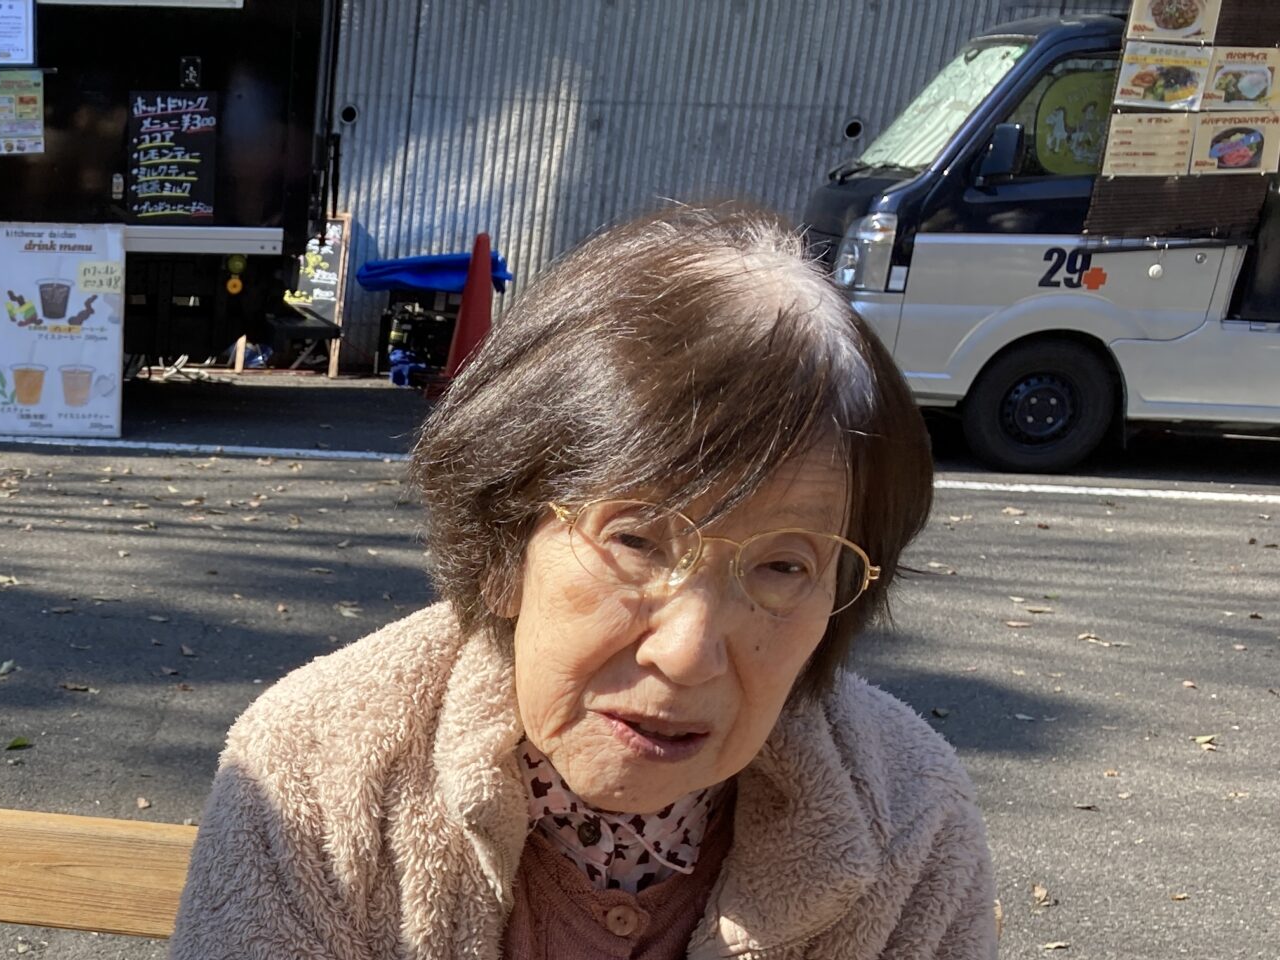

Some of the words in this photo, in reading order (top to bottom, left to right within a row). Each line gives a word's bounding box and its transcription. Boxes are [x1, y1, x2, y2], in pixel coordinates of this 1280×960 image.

[132, 96, 208, 115] ホットドリンク
[140, 131, 174, 144] ココア
[140, 147, 200, 160] レモンティー
[139, 165, 196, 178] ミルクティー
[24, 240, 57, 252] drink
[58, 243, 93, 252] menu
[1038, 246, 1092, 288] 29
